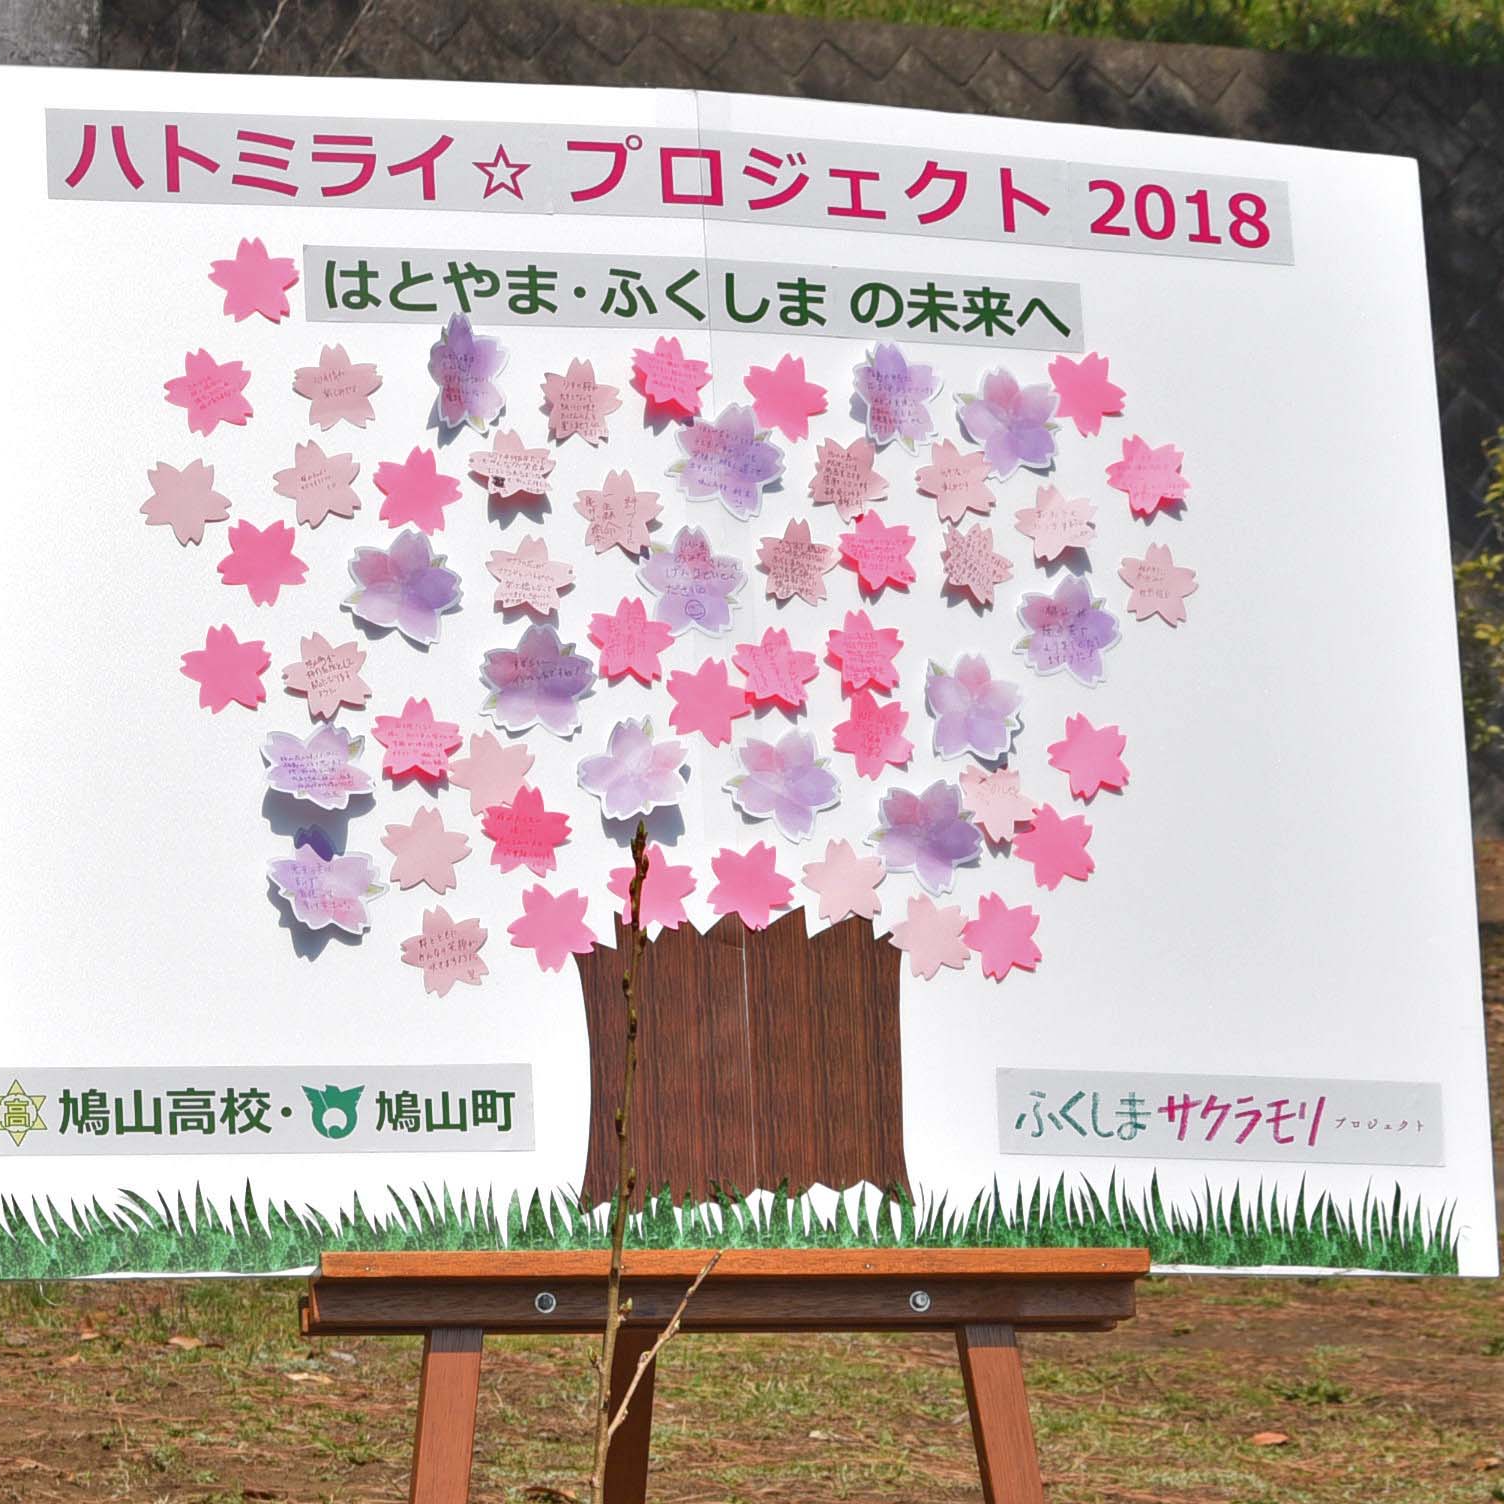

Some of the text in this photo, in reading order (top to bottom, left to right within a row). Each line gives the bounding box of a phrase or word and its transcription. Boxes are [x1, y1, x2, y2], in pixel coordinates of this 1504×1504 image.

[1089, 179, 1270, 249] 2018
[375, 1089, 516, 1133] 鳩山町
